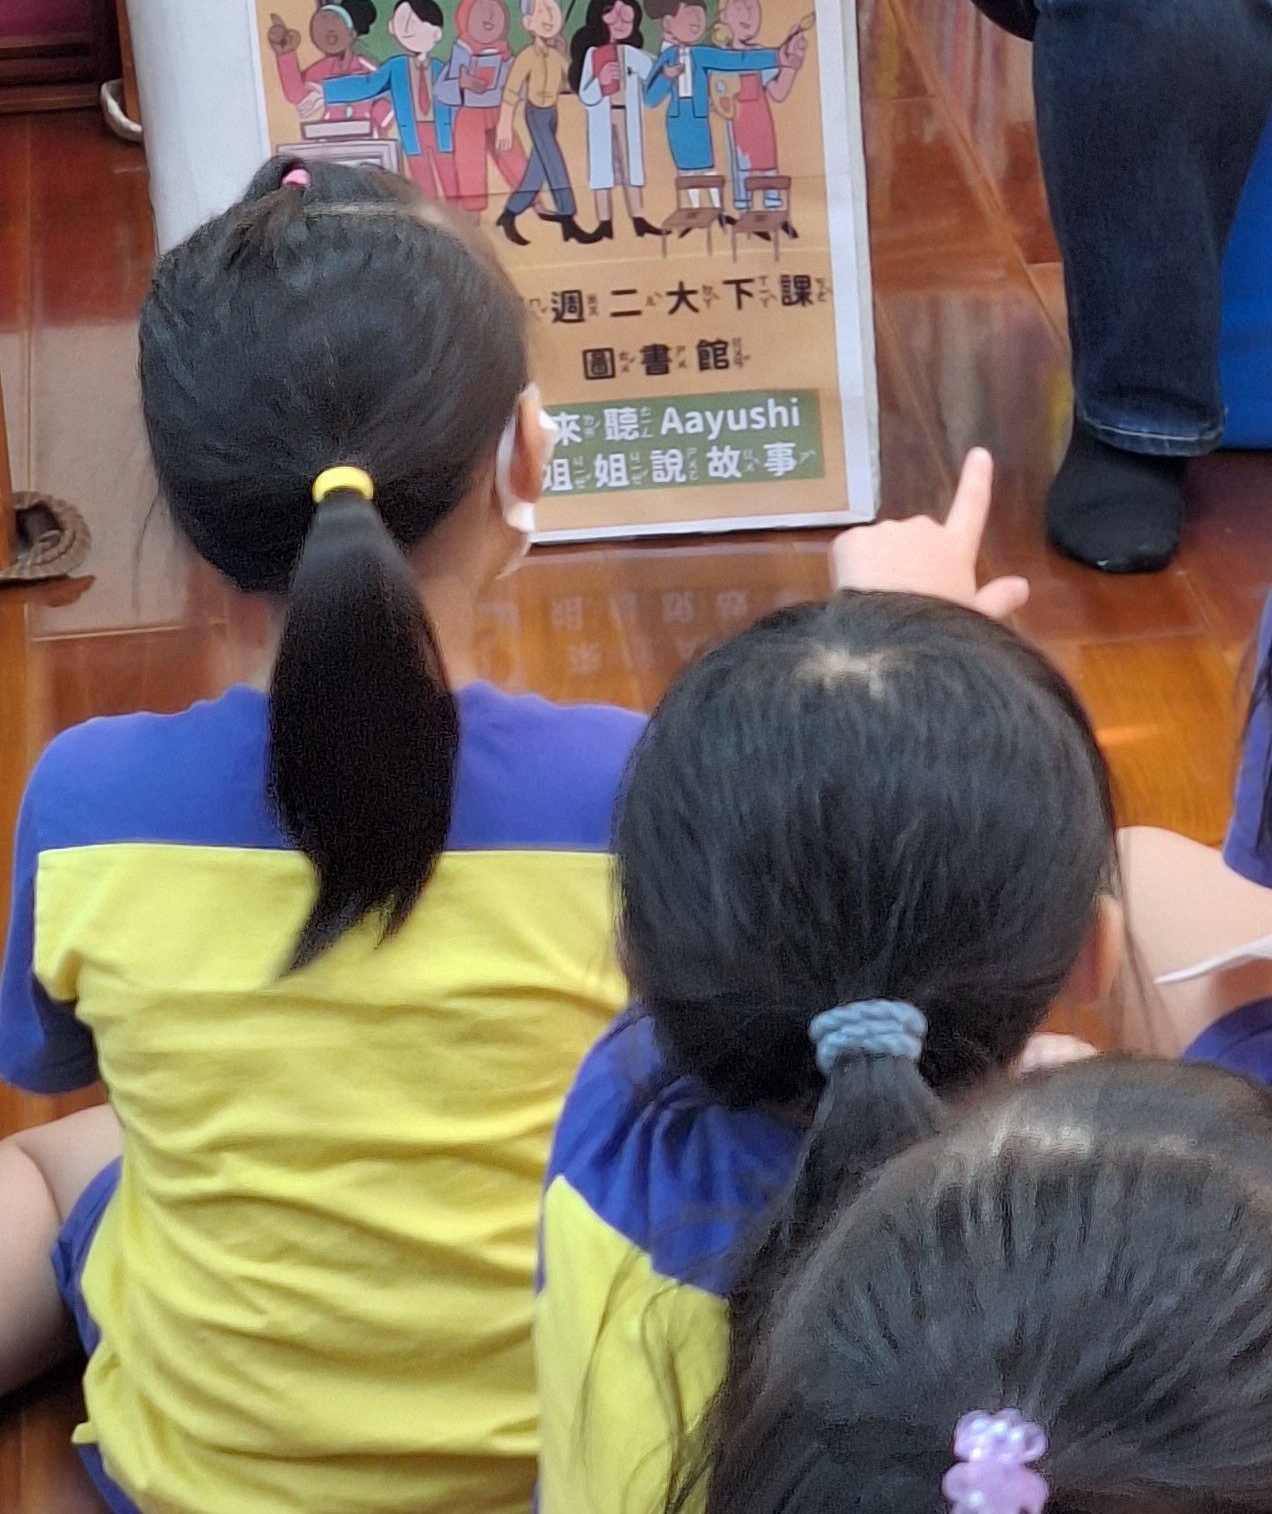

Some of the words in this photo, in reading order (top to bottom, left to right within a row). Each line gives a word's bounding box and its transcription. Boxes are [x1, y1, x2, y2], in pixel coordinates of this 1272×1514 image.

[582, 339, 731, 381] 圖書館
[660, 397, 801, 440] Aayushi
